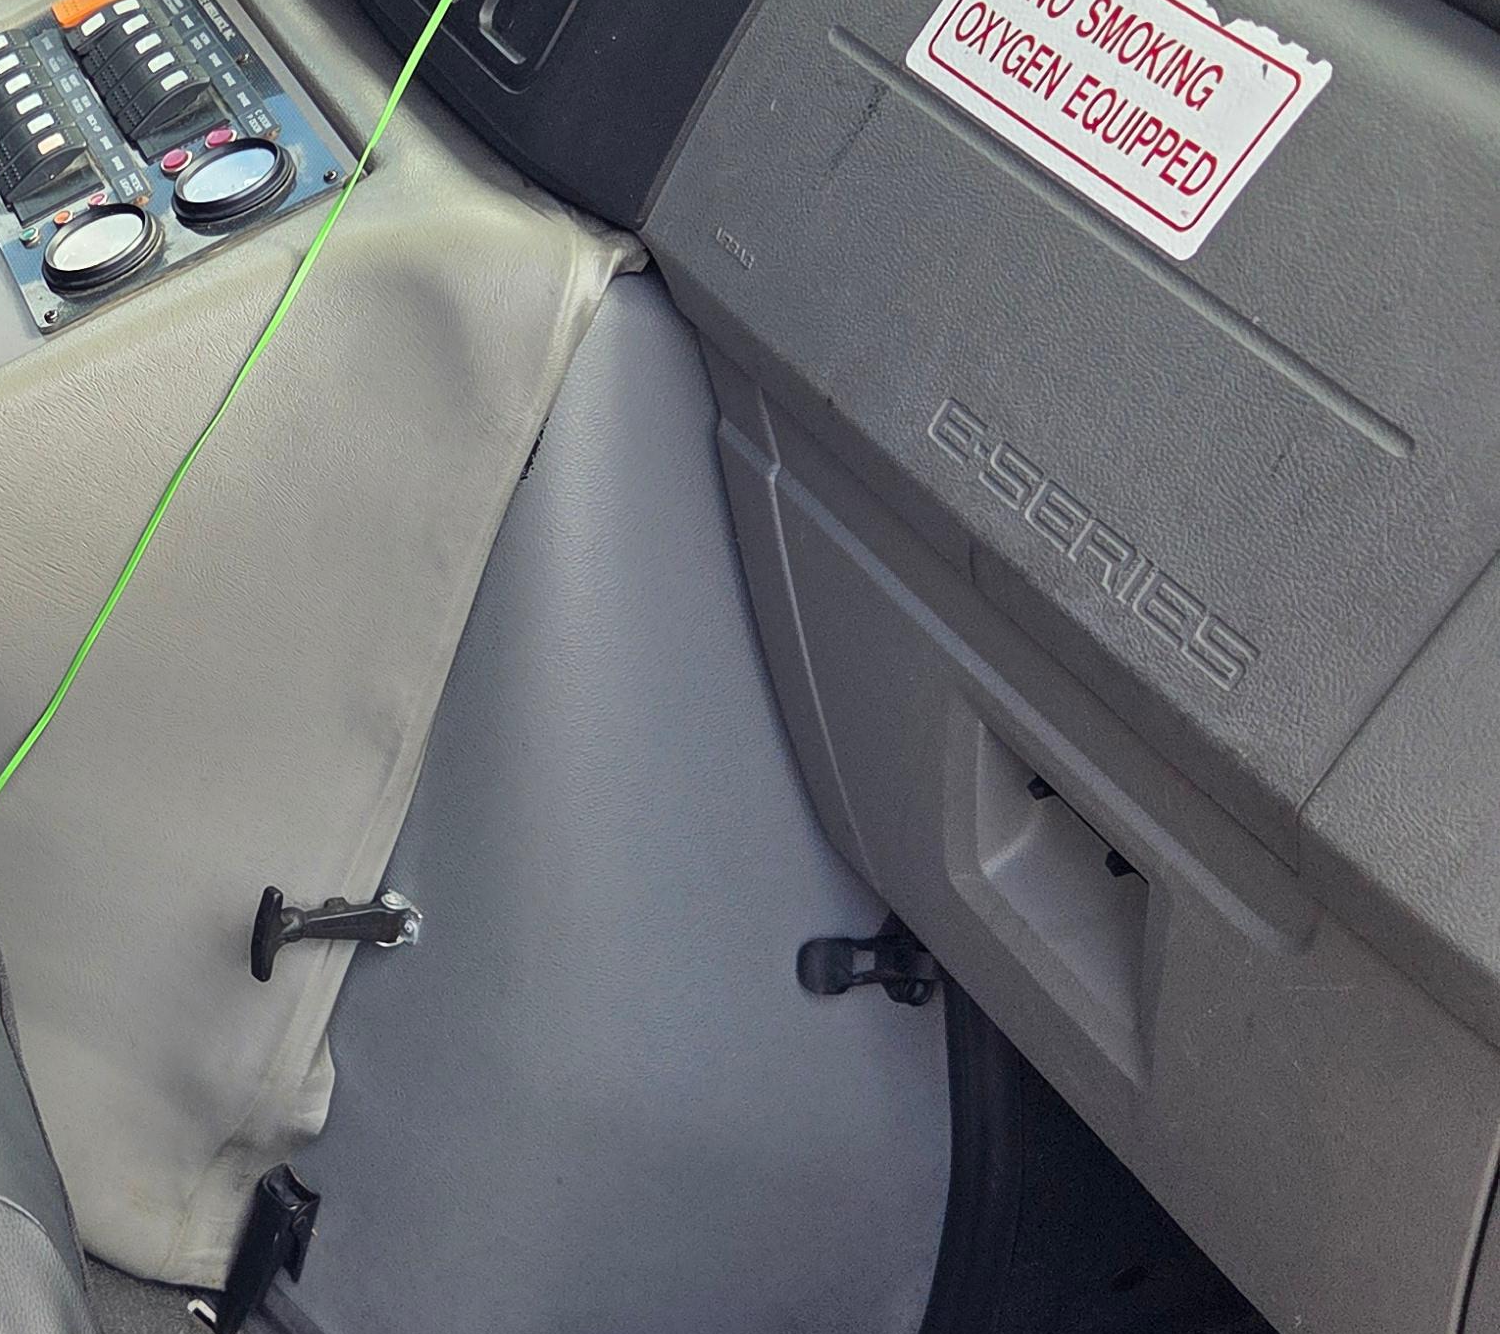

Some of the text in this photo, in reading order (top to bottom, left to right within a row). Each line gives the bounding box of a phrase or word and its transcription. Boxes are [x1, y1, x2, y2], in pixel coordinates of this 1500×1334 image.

[954, 1, 1219, 197] OXYGEN EQUIPPED
[927, 396, 1261, 692] E-SERIES
